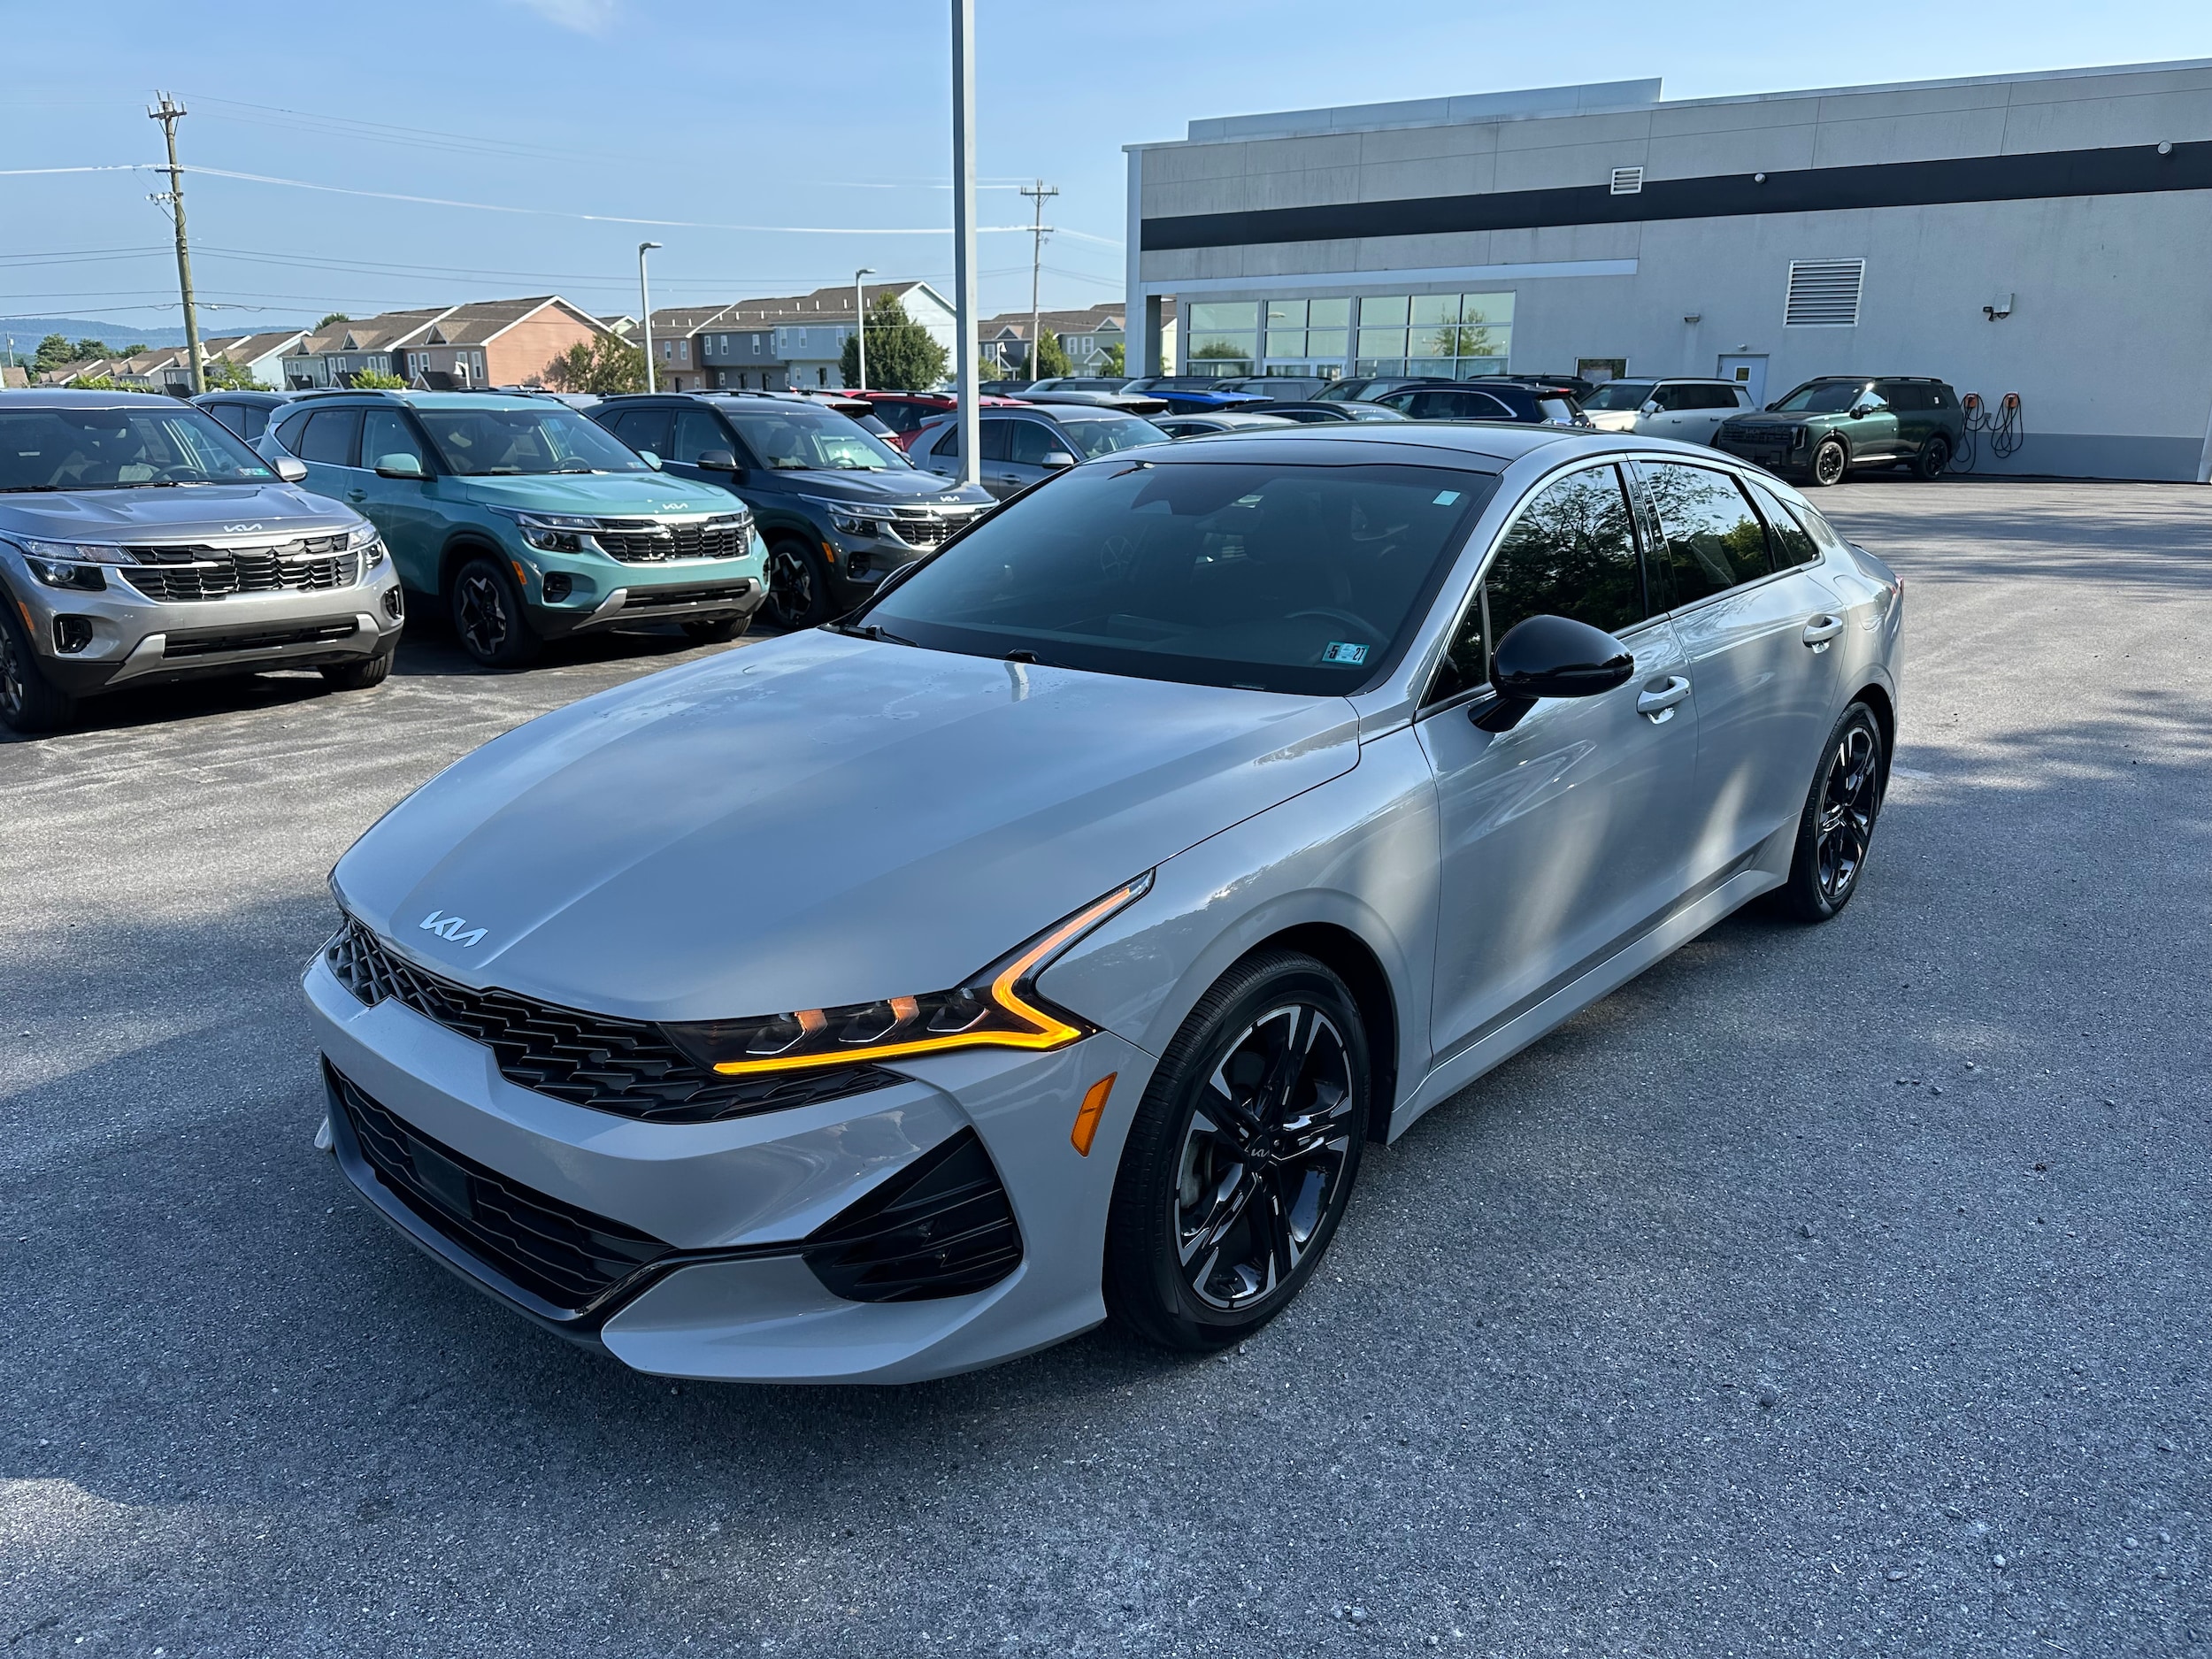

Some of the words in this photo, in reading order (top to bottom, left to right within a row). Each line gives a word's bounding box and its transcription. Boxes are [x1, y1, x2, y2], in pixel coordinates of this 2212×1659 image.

[223, 523, 263, 533] KIA
[1352, 647, 1366, 662] 27
[419, 910, 488, 949] KIA
